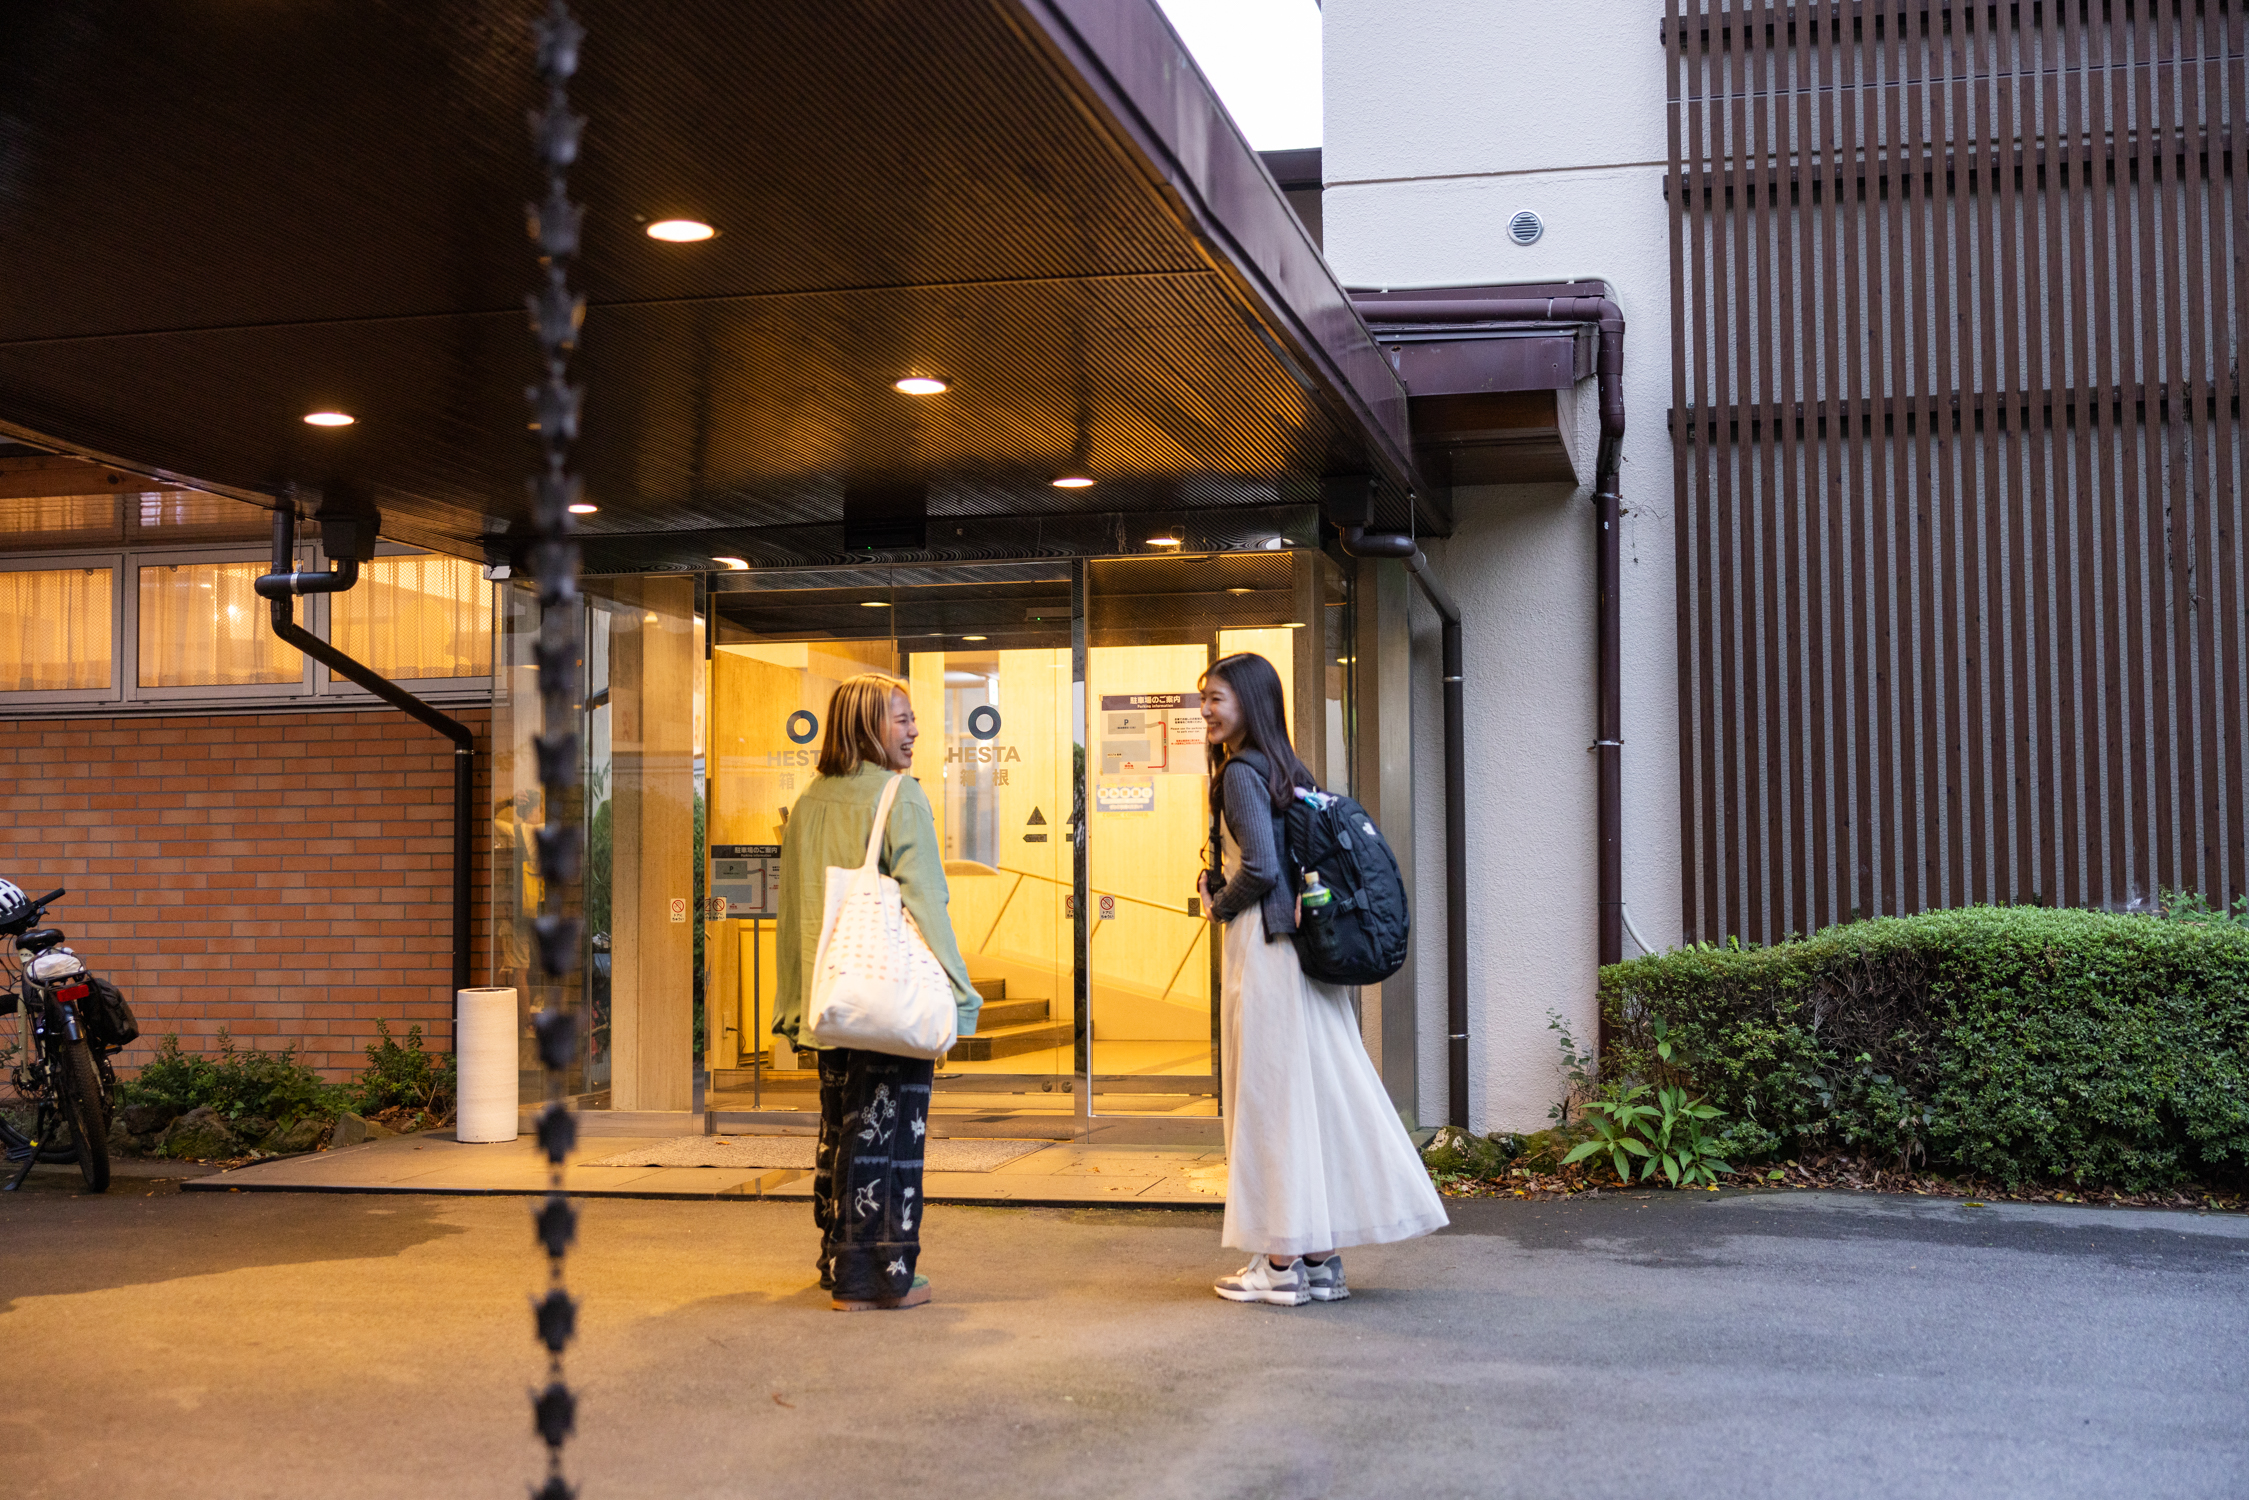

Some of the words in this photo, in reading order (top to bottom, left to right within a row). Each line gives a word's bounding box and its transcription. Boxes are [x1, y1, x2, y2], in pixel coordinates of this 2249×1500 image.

[1130, 695, 1180, 704] 駐車場のご案内
[767, 750, 822, 766] HEST
[948, 746, 1021, 763] HESTA
[960, 768, 1010, 787] 箱根
